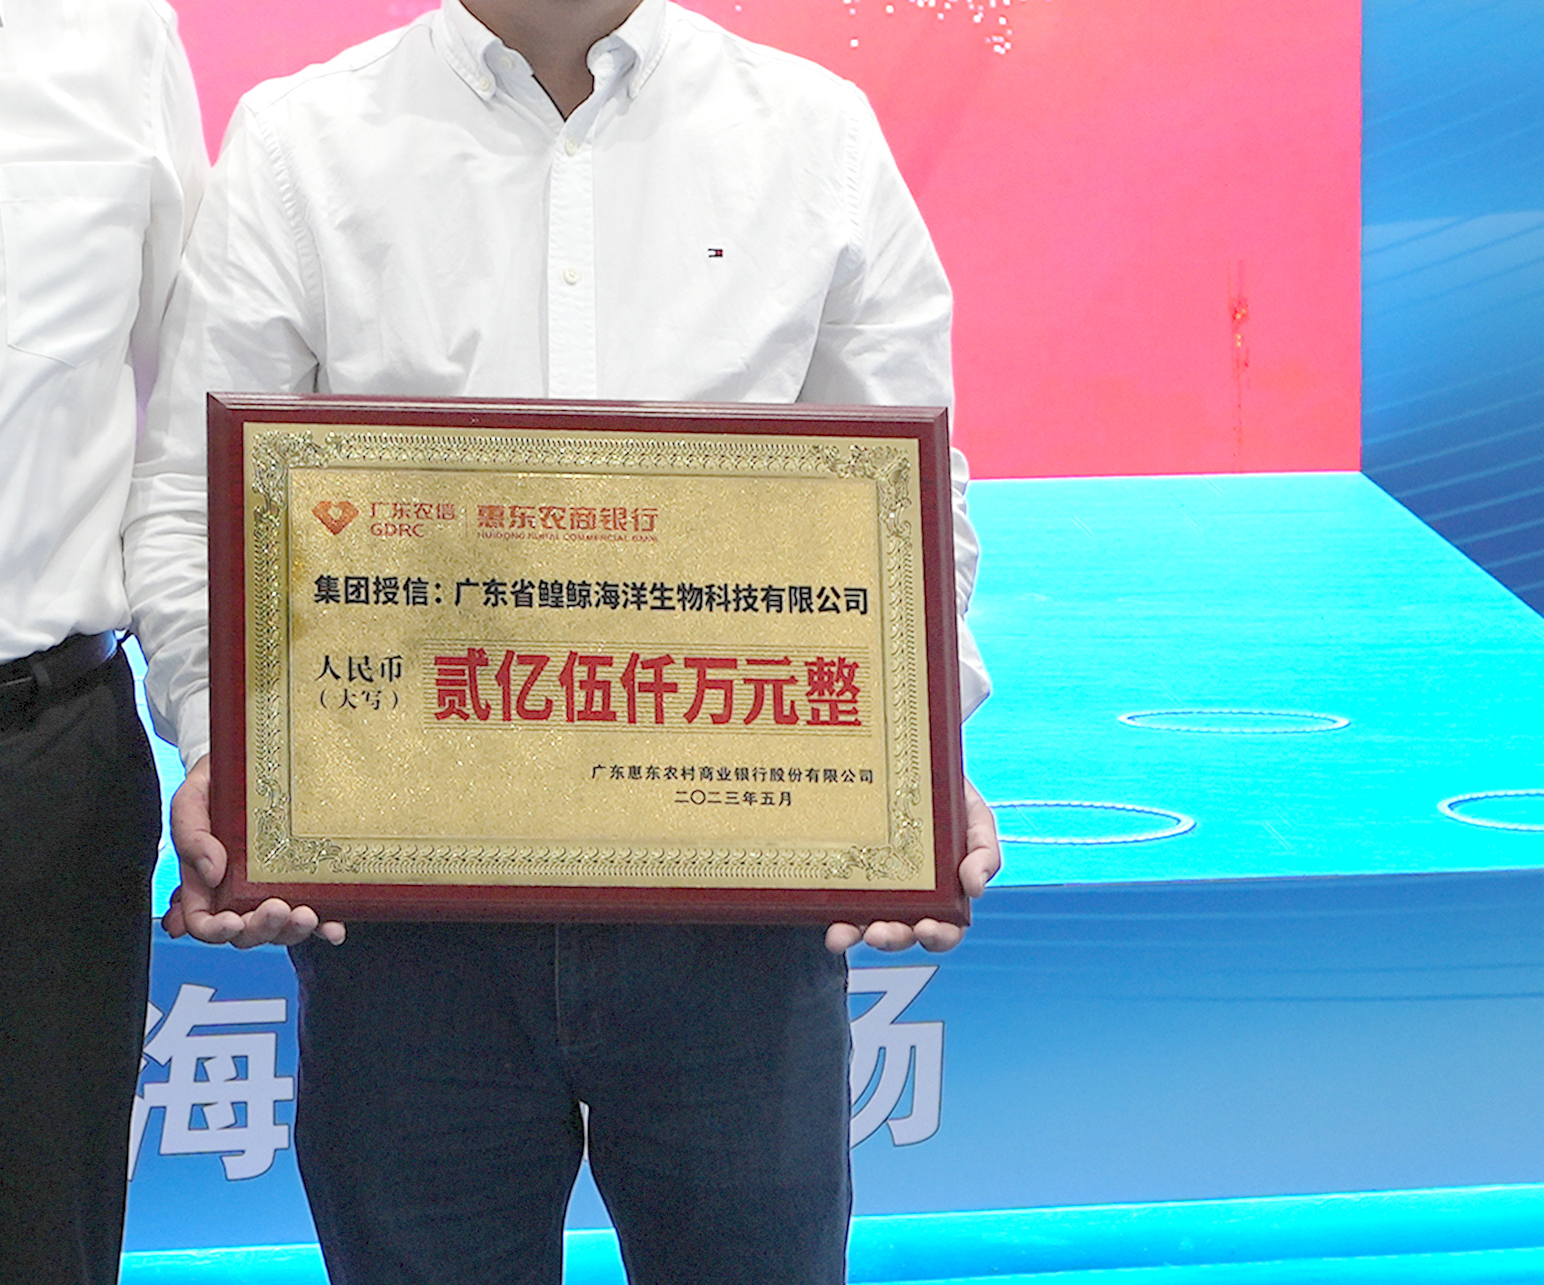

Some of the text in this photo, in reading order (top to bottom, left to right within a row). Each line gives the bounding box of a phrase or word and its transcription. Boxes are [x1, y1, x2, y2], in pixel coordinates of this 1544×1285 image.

[370, 500, 455, 523] 广东农信
[477, 503, 659, 532] 惠东农商银行
[370, 523, 425, 539] GDRC
[316, 653, 403, 682] 人民币
[433, 647, 863, 728] 贰亿伍仟万元整
[591, 764, 874, 784] 广东惠东农村商业银行股份有限公司
